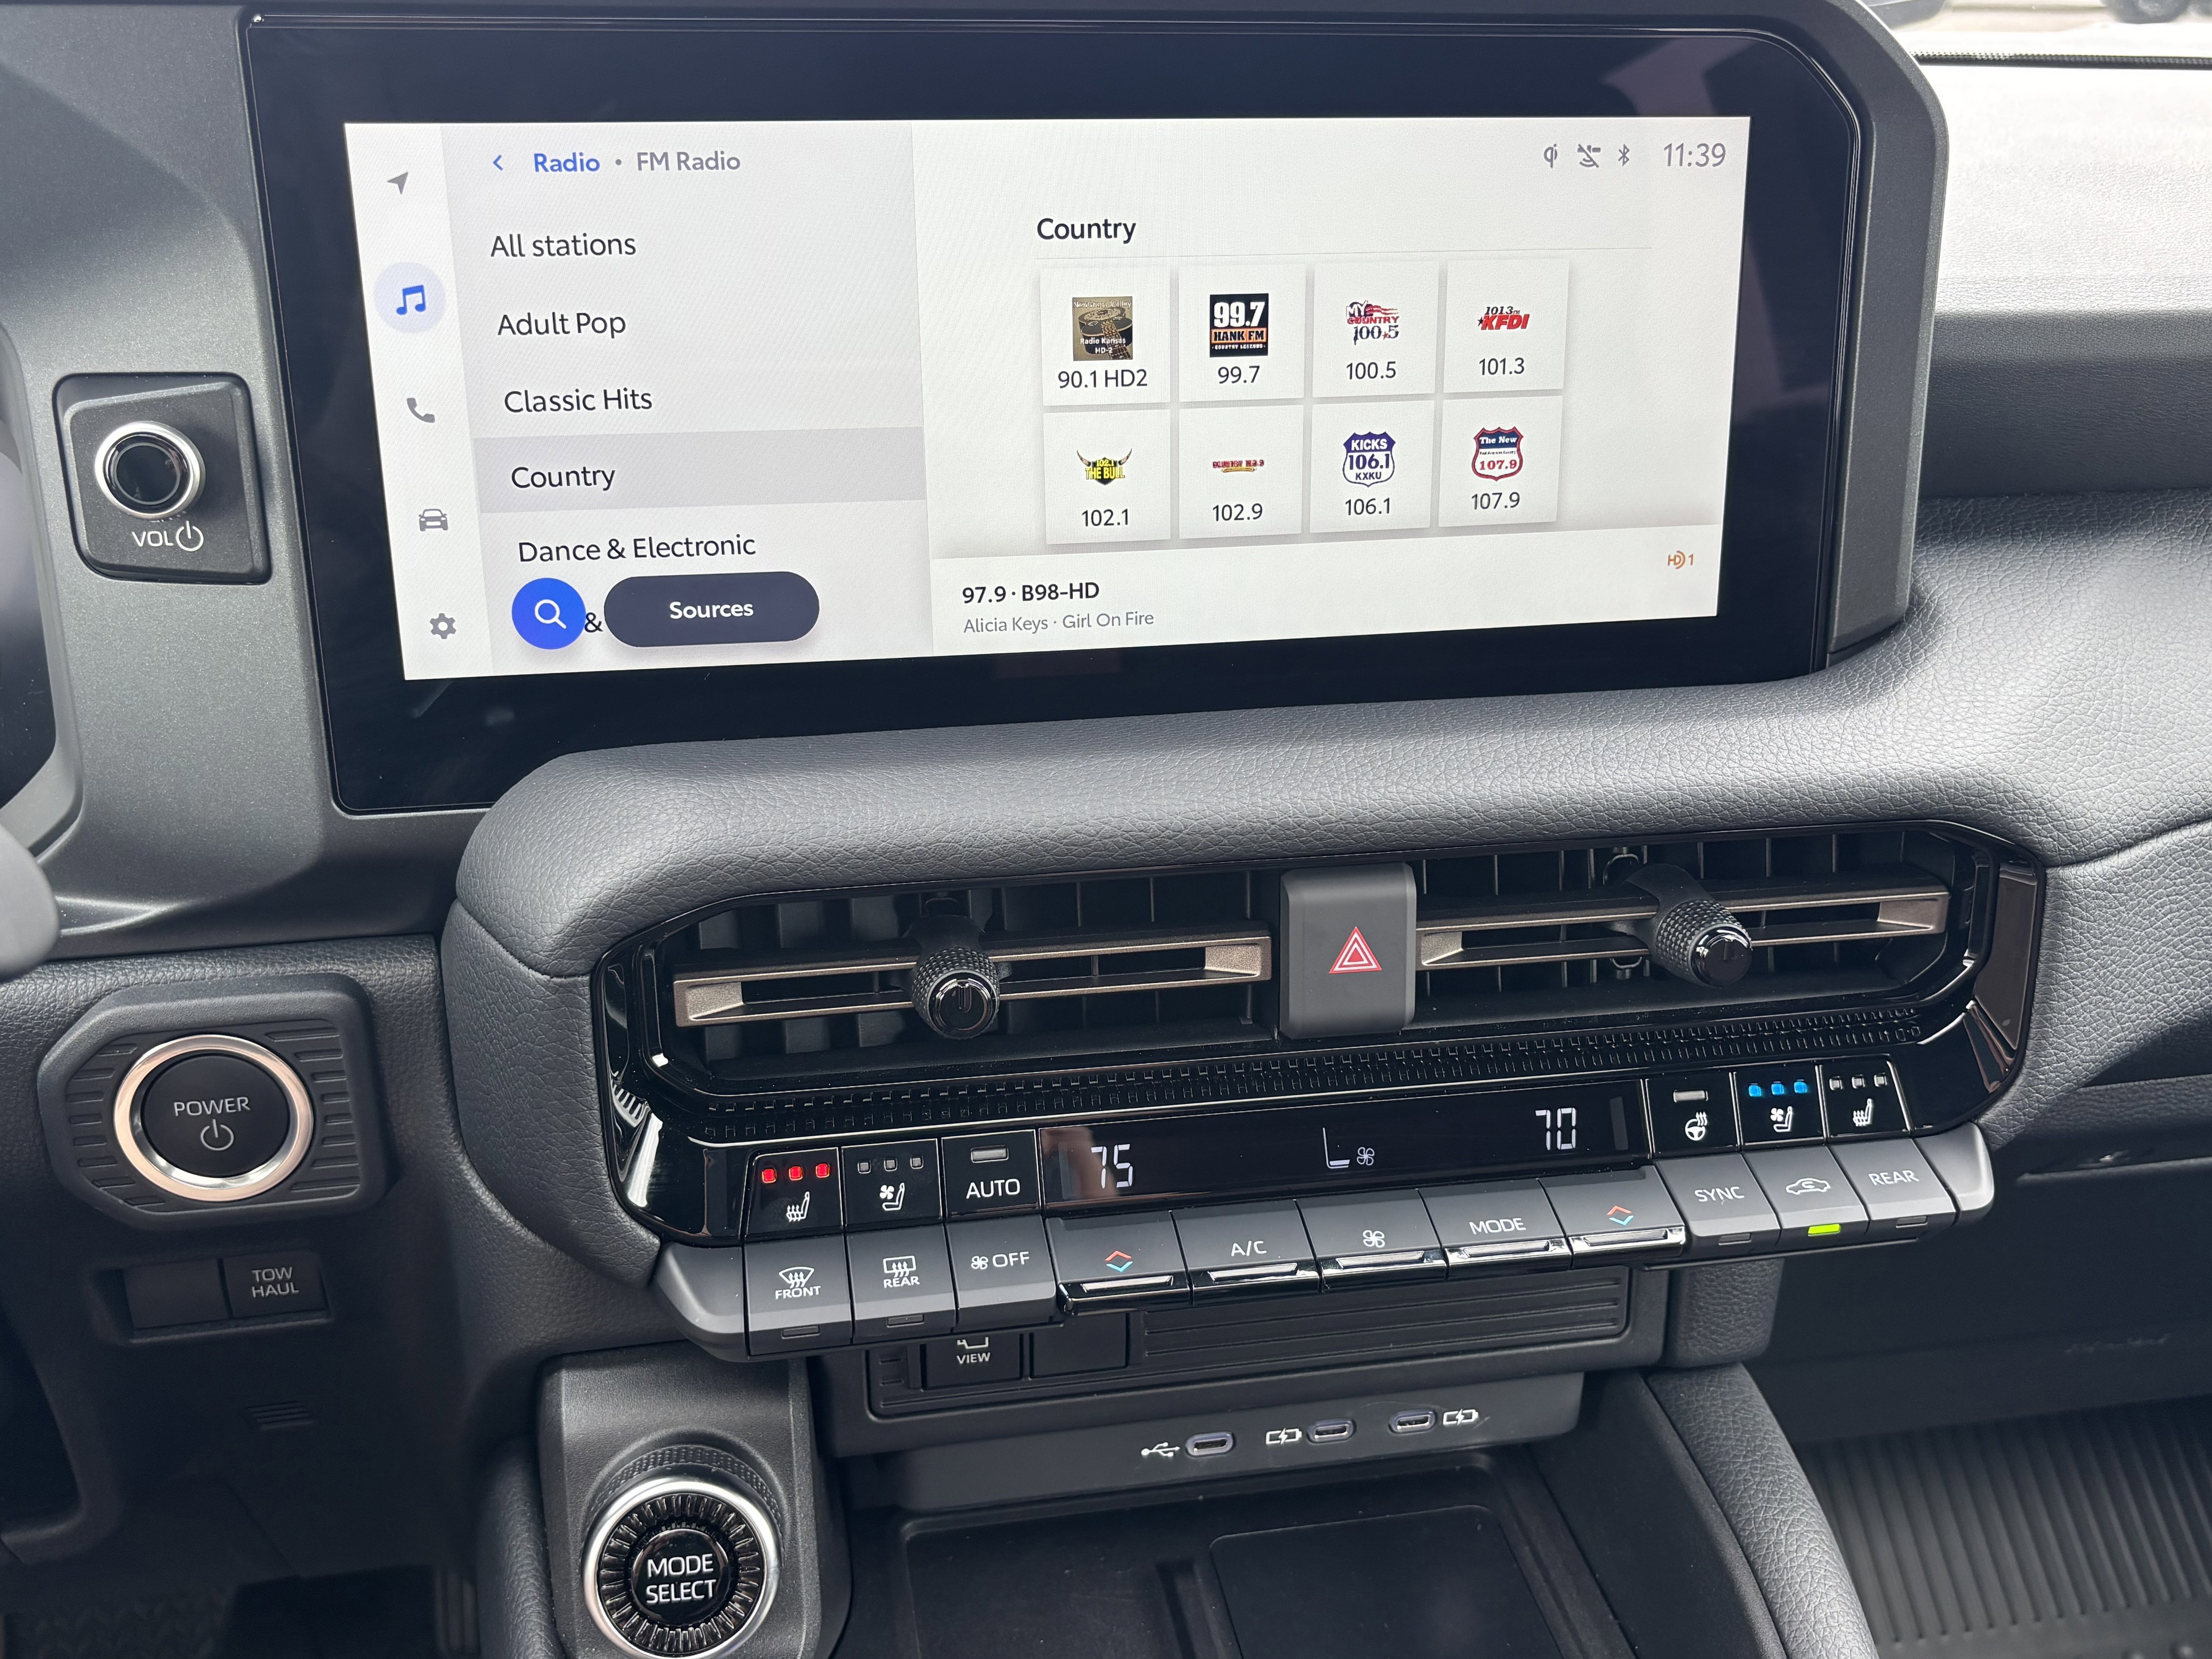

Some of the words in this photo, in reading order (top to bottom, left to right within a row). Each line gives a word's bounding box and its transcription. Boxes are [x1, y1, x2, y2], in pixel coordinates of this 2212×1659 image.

[534, 152, 600, 172] Radio
[637, 152, 670, 171] FM
[677, 150, 740, 171] Radio
[1664, 143, 1726, 167] 11:39
[1037, 218, 1136, 244] Country
[491, 234, 526, 257] All
[532, 232, 636, 257] stations
[1214, 301, 1266, 328] 99.7
[1346, 300, 1369, 319] MY
[498, 312, 570, 335] Adult
[576, 313, 626, 339] Pop
[1347, 316, 1400, 325] COUNTRY
[1480, 313, 1530, 330] KFDI
[1213, 331, 1245, 342] HANK
[1248, 330, 1264, 341] FM
[1218, 365, 1260, 384] 99.7
[1346, 361, 1396, 380] 100.5
[1479, 357, 1525, 376] 101.3
[1058, 370, 1096, 389] 90.1
[1105, 369, 1147, 388] HD2
[504, 388, 596, 413] Classic
[603, 387, 652, 410] Hits
[1351, 438, 1388, 451] KICKS
[1348, 453, 1390, 470] 106.1
[1479, 459, 1517, 471] 107.9
[511, 466, 615, 491] Country
[1085, 467, 1102, 480] THE
[1103, 466, 1125, 479] BULL
[1355, 471, 1382, 481] KXKU
[1345, 497, 1390, 516] 106.1
[1472, 492, 1520, 510] 107.9
[1082, 508, 1128, 527] 102.1
[1212, 503, 1263, 522] 102.9
[132, 531, 174, 547] VOL
[519, 542, 601, 562] Dance
[607, 538, 626, 560] &
[633, 534, 756, 558] Electronic
[962, 586, 1006, 604] 97.9
[1022, 582, 1099, 601] B98-HD
[670, 601, 754, 619] Sources
[963, 617, 1007, 633] Alicia
[1012, 617, 1048, 634] Keys
[1062, 613, 1092, 629] Girl
[1096, 613, 1121, 627] On
[1126, 611, 1154, 626] Fire
[174, 1097, 250, 1116] POWER
[1535, 1108, 1576, 1151] 70
[1090, 1142, 1134, 1190] 75
[1868, 1170, 1920, 1185] REAR
[966, 1178, 1020, 1199] AUTO
[1694, 1186, 1745, 1202] SYNC
[1469, 1218, 1527, 1235] MODE
[1231, 1241, 1267, 1257] A/C
[992, 1251, 1029, 1267] OFF
[252, 1267, 293, 1282] TOW
[883, 1276, 921, 1288] REAR
[252, 1282, 299, 1298] HAUL
[775, 1285, 821, 1300] FRONT
[957, 1352, 991, 1364] VIEW
[647, 1553, 714, 1578] MODE
[646, 1578, 716, 1604] SELECT
